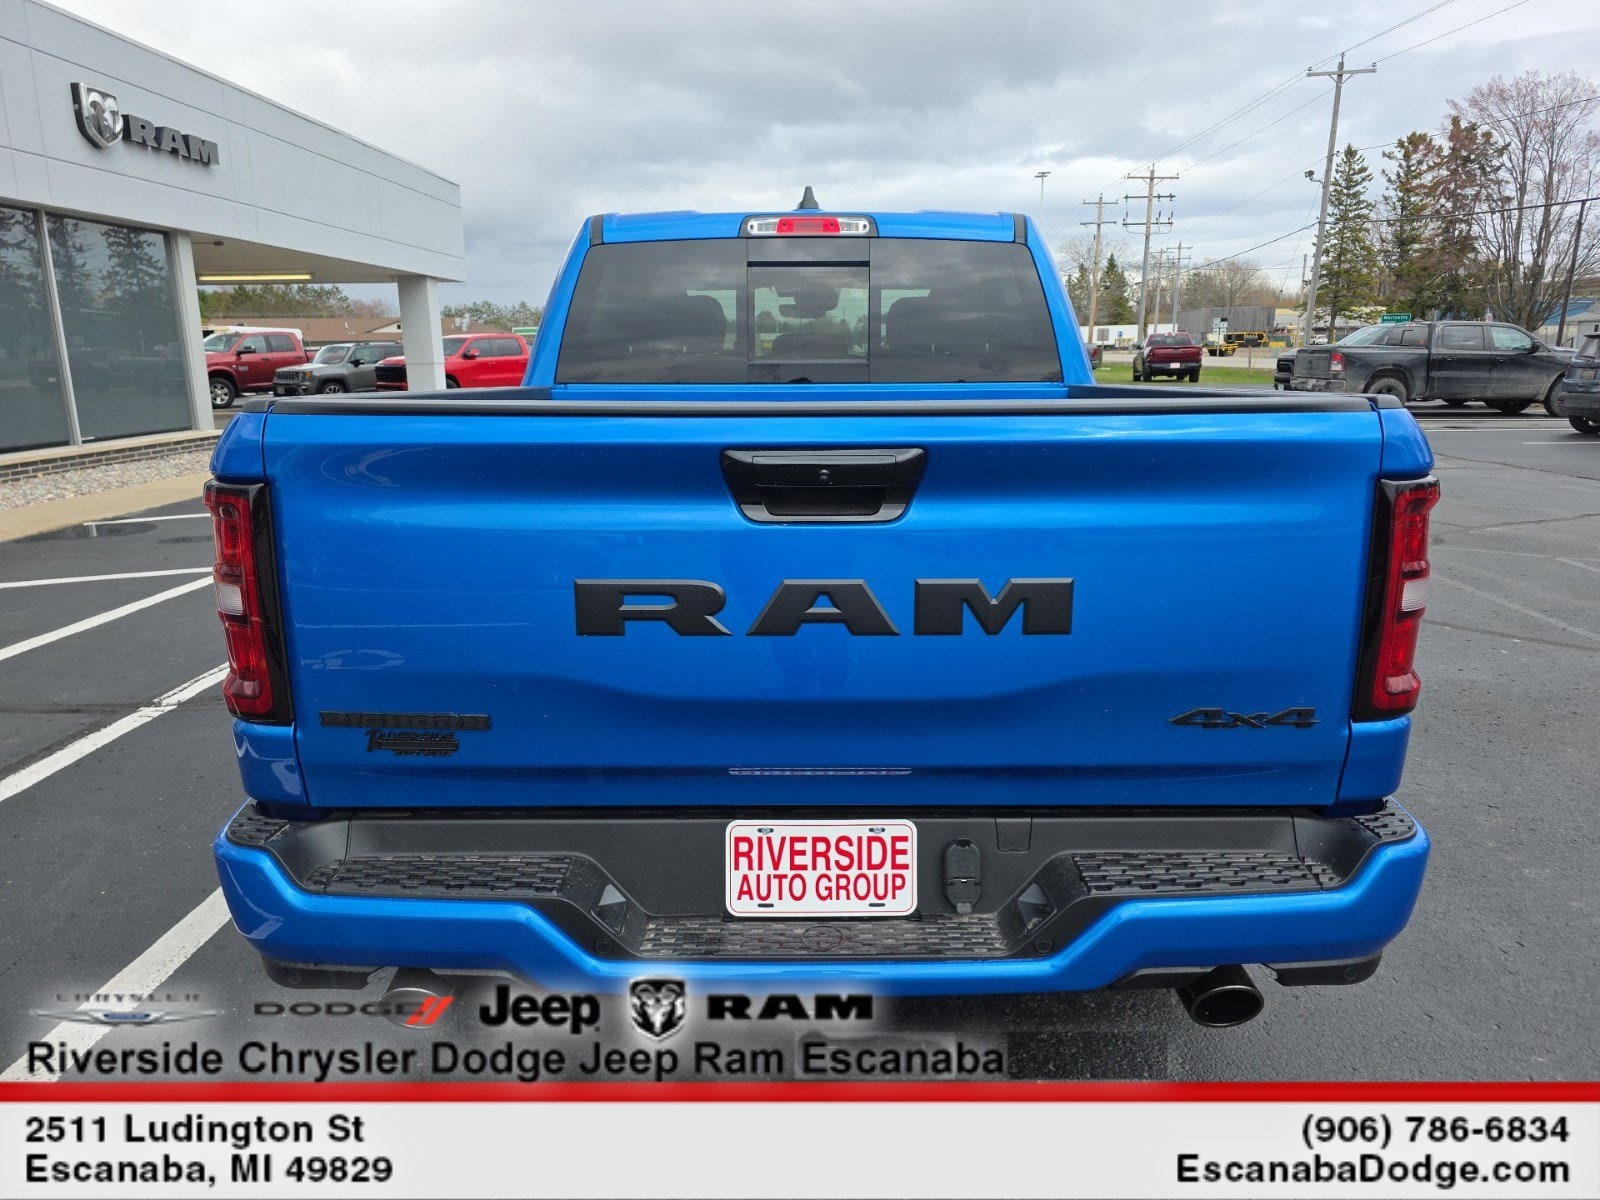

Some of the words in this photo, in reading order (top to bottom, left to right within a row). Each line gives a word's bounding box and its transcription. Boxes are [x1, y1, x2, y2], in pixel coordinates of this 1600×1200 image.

[121, 114, 219, 165] RAM
[574, 577, 1074, 636] RAM
[733, 835, 909, 871] RIVERSIDE
[737, 873, 807, 902] AUTO
[815, 873, 906, 902] GROUP
